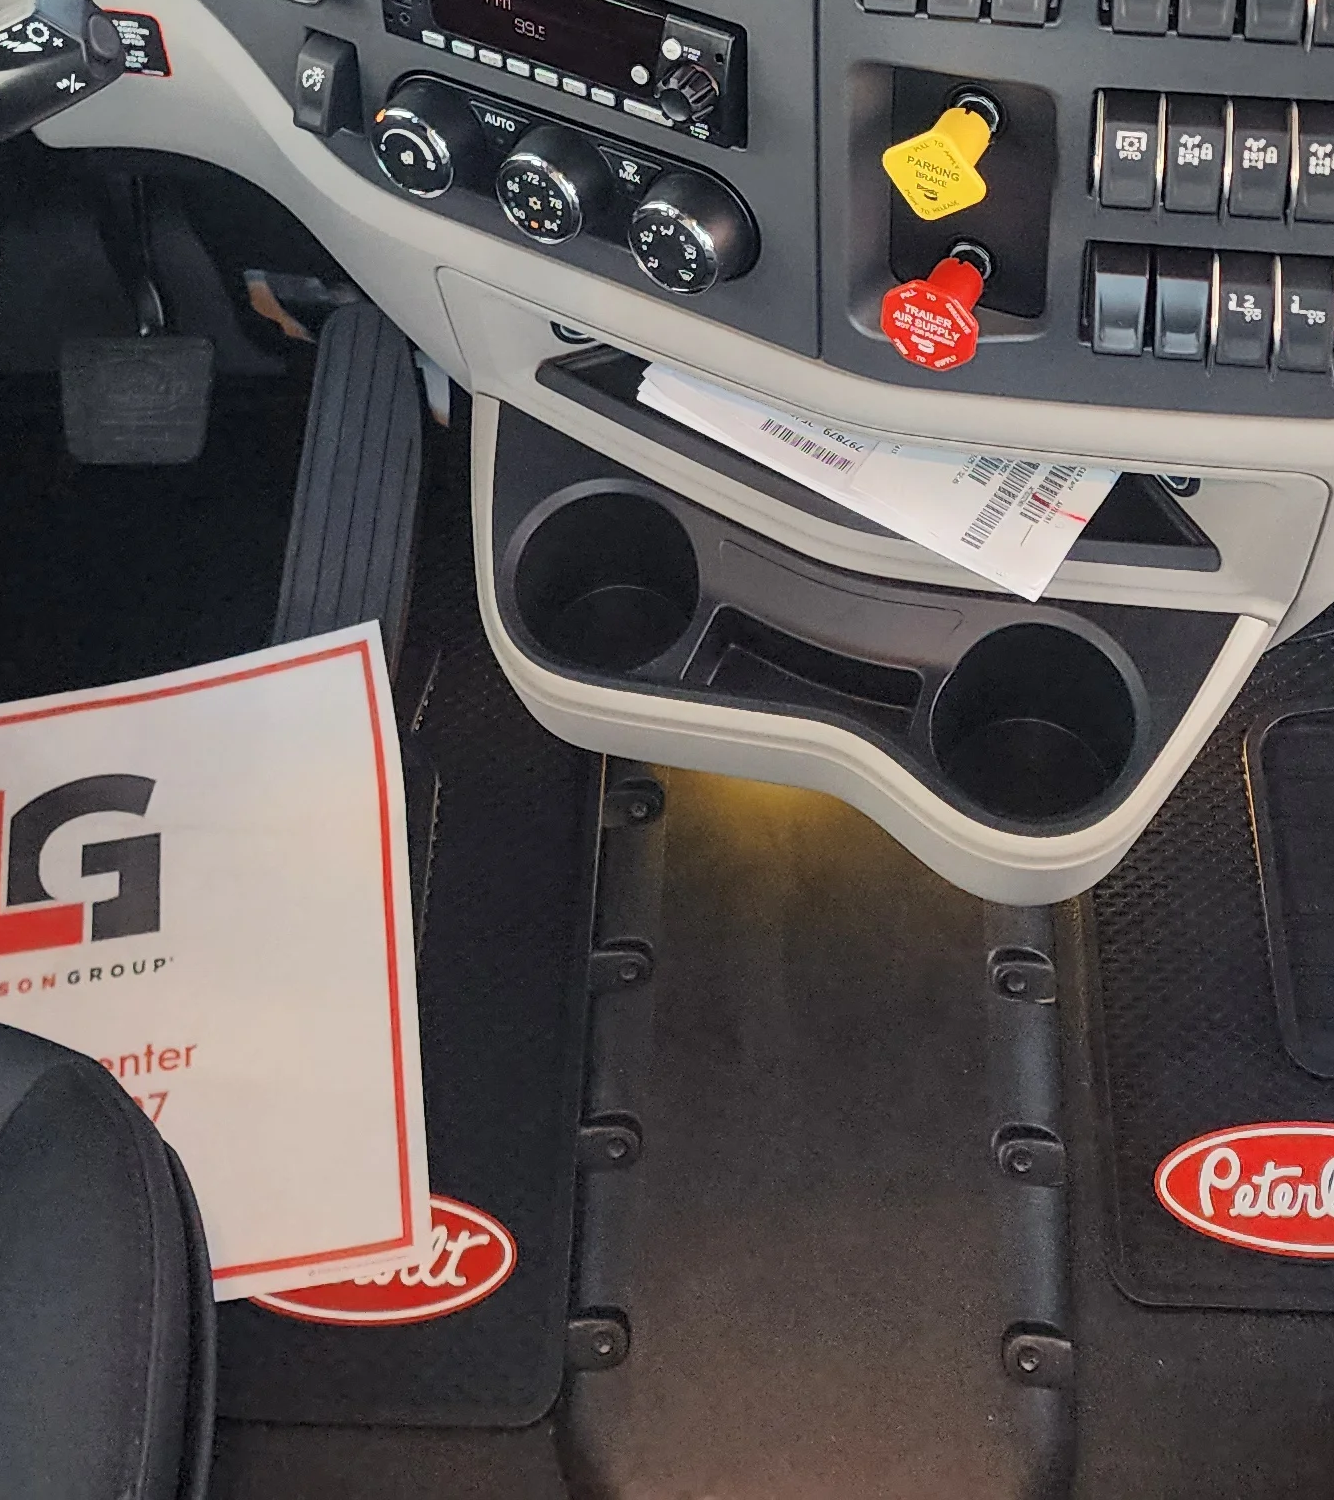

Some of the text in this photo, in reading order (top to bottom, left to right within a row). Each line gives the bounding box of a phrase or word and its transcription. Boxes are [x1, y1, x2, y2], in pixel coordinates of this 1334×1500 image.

[484, 112, 516, 132] AUTO
[933, 139, 944, 148] TO
[1118, 152, 1142, 161] PTO
[906, 155, 960, 182] PARKING
[527, 171, 540, 185] 72
[618, 169, 641, 185] MAX
[915, 170, 947, 188] BRAKE
[926, 292, 937, 301] TO
[904, 303, 953, 329] TRAILER
[893, 310, 913, 325] AIR
[914, 318, 961, 342] SUPPLY
[894, 320, 911, 330] NOT
[909, 325, 925, 336] FOR
[915, 354, 927, 363] TO
